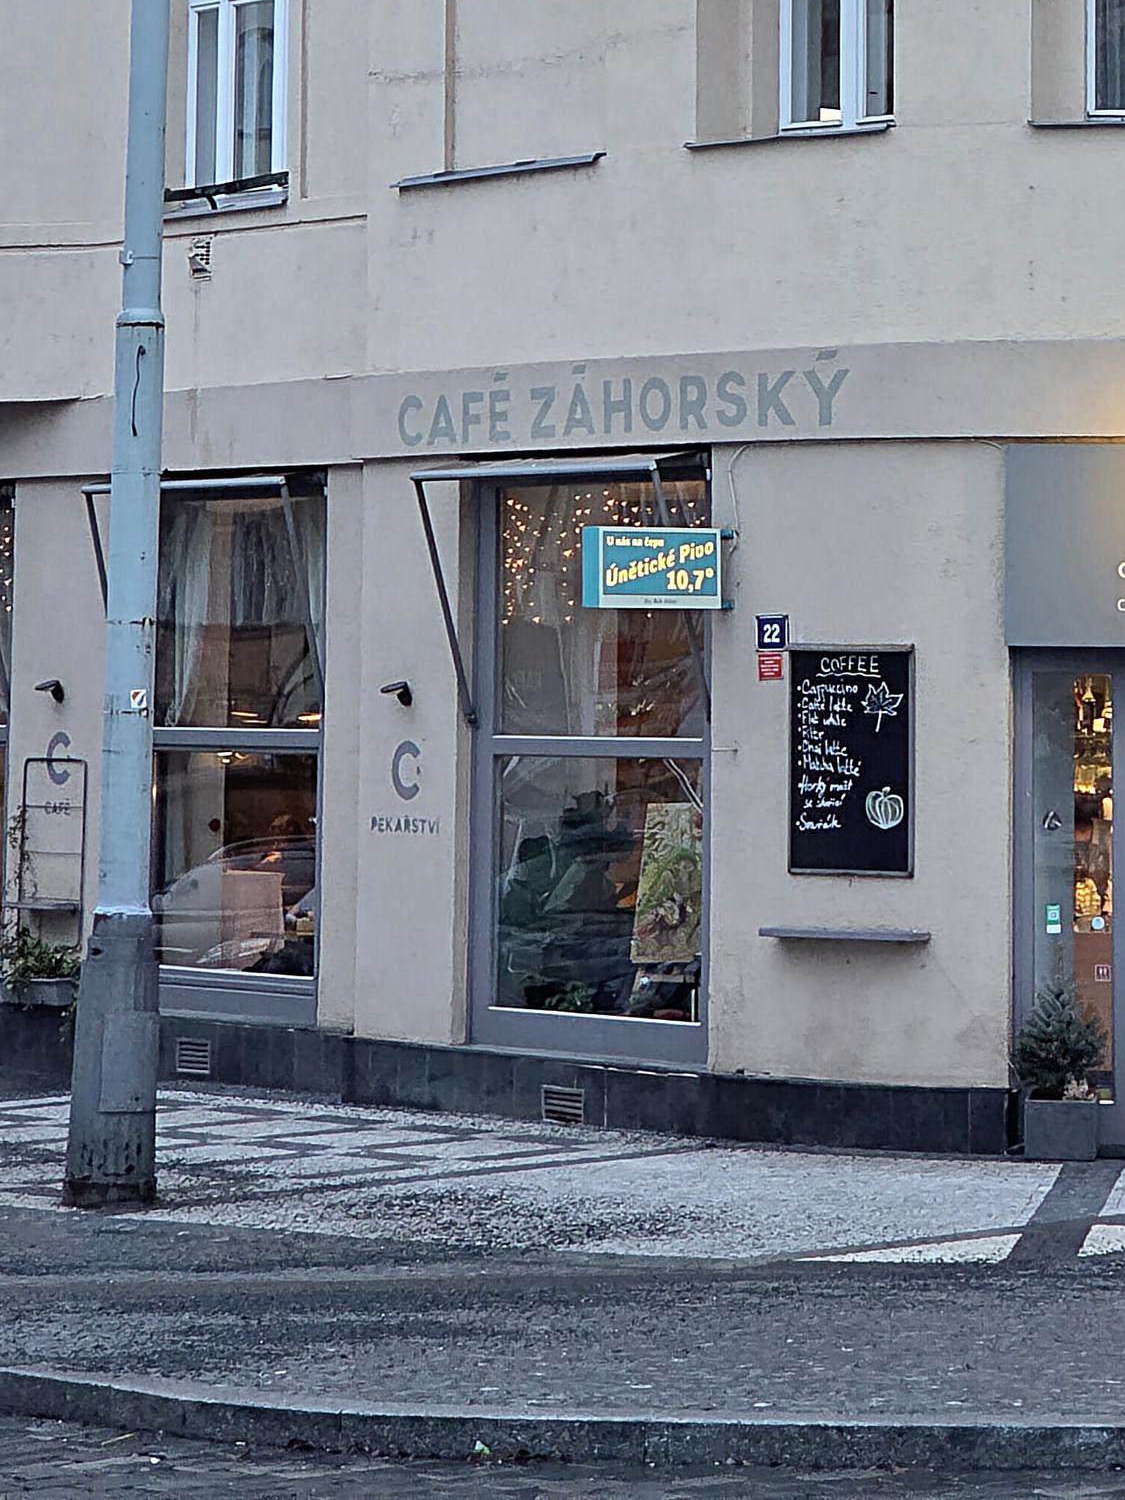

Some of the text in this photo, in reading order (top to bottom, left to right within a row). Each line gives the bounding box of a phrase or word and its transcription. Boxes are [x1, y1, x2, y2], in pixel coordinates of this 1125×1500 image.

[398, 349, 850, 447] CAFÉ ZÁHORSKÝ
[606, 535, 614, 546] U
[605, 541, 715, 587] Únětické Pivo
[763, 623, 780, 643] 22
[820, 655, 880, 673] COFFEE
